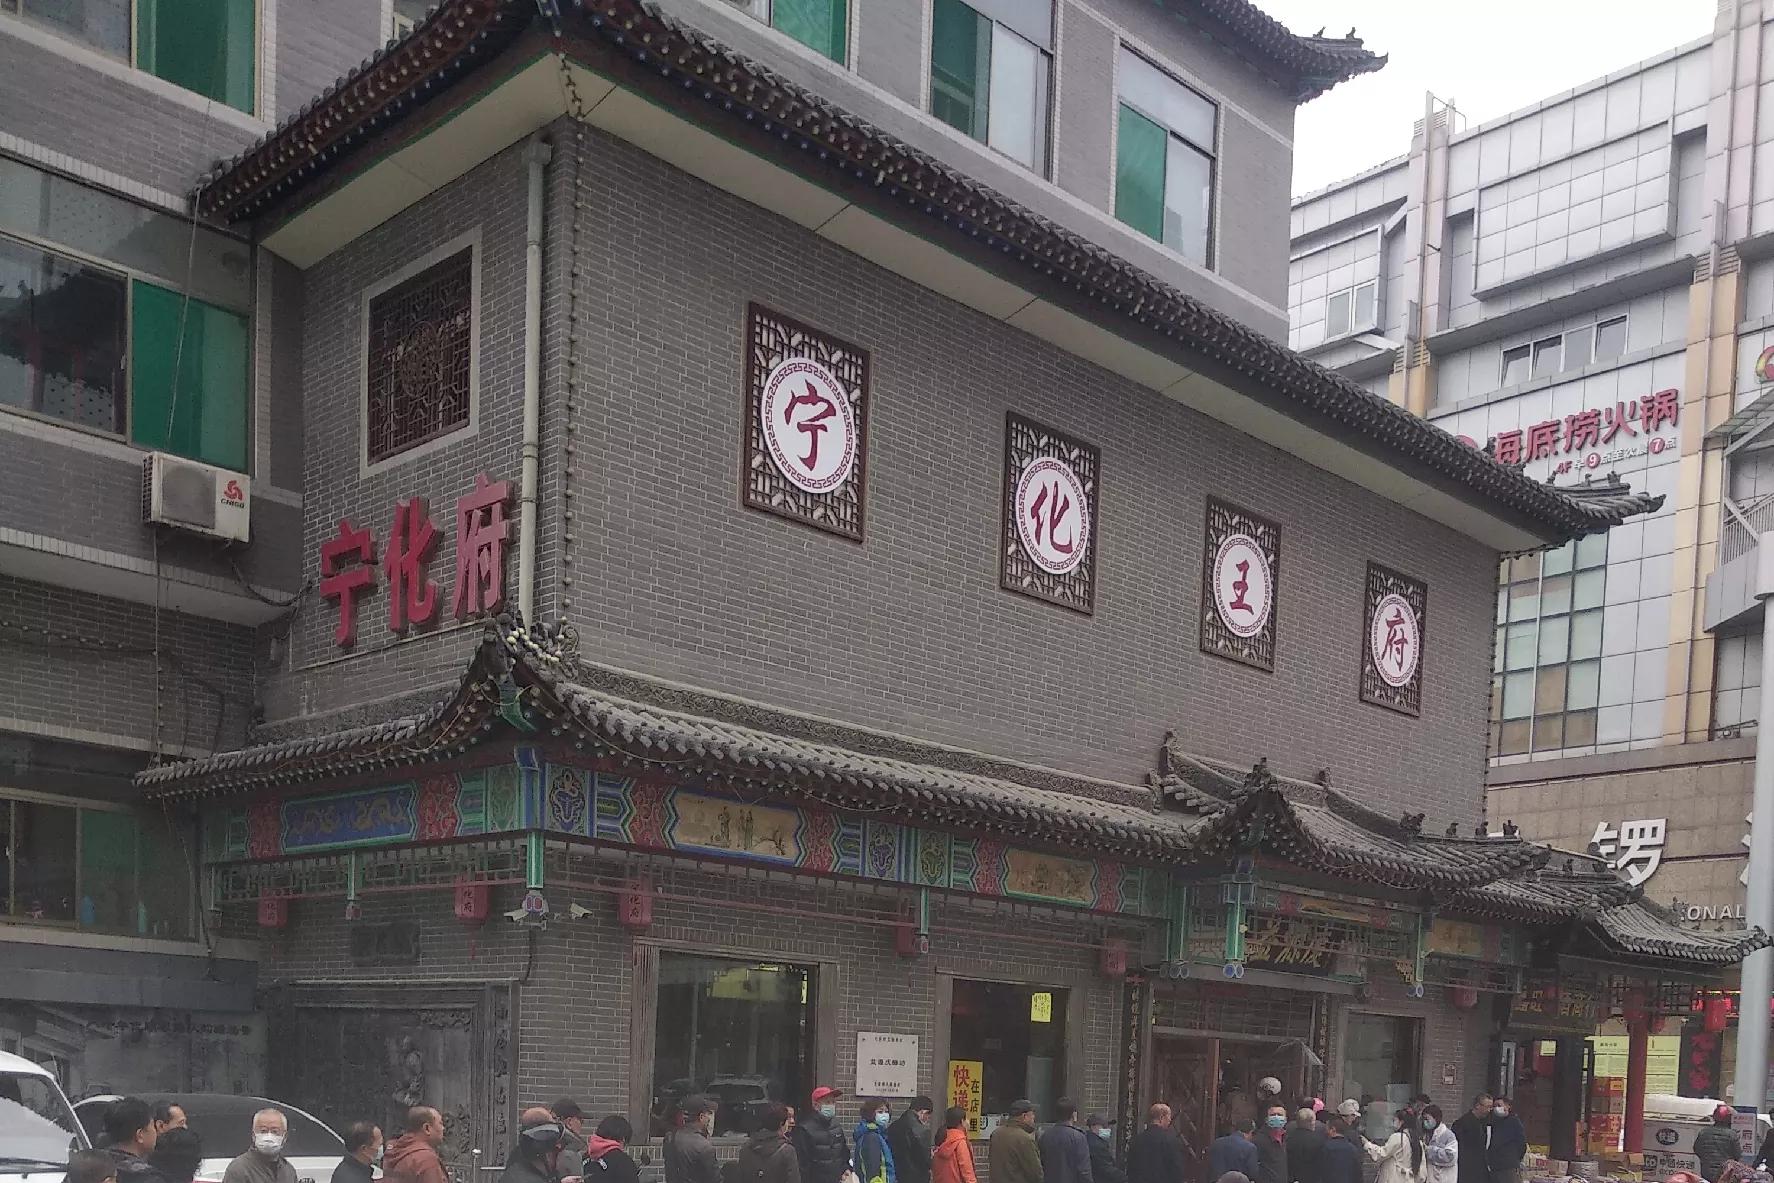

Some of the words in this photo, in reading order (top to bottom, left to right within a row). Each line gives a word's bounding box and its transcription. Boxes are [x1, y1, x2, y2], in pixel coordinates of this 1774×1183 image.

[1495, 388, 1680, 466] 海底捞火锅
[319, 471, 514, 646] 宁化府
[784, 380, 837, 471] 宁
[1030, 480, 1073, 554] 化
[1229, 559, 1255, 615] 王
[1381, 608, 1408, 672] 府
[1590, 818, 1668, 887] 锣
